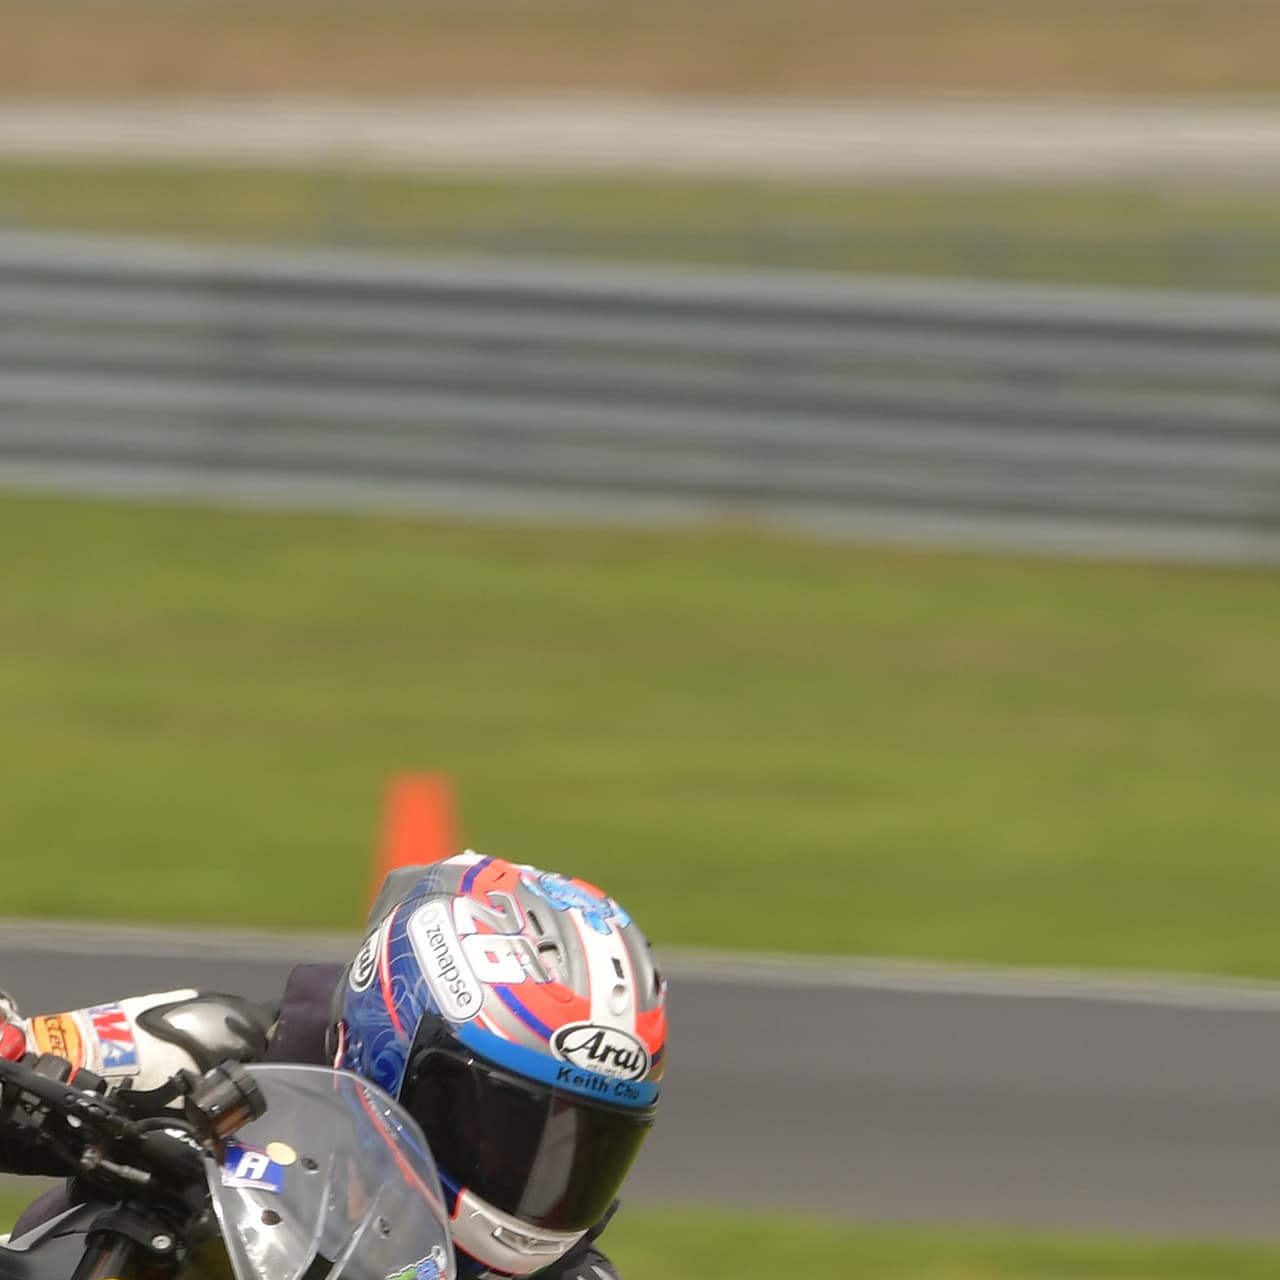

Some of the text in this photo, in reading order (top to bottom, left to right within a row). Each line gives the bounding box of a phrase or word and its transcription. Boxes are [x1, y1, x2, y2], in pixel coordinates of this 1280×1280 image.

[425, 924, 473, 1008] zenapse
[561, 1031, 640, 1073] Arai
[556, 1066, 608, 1094] Keith
